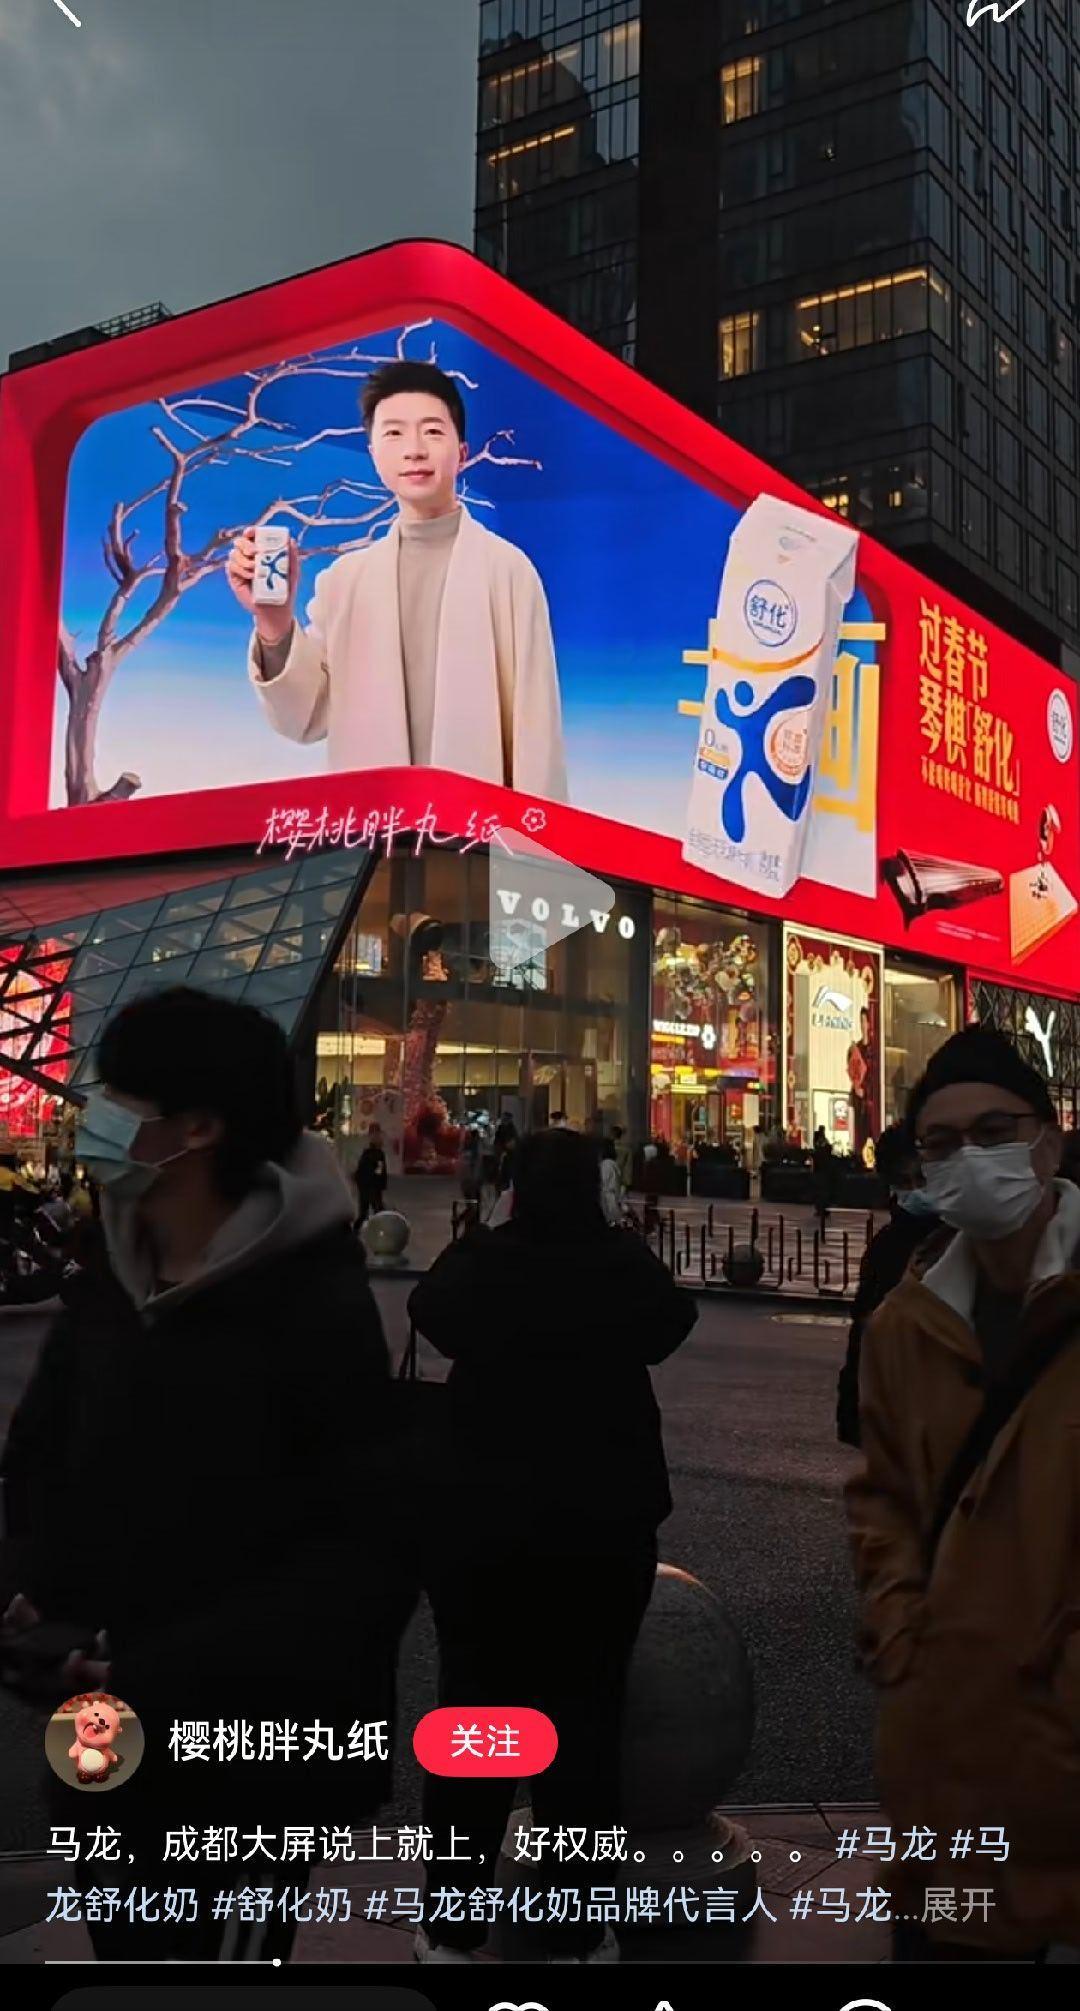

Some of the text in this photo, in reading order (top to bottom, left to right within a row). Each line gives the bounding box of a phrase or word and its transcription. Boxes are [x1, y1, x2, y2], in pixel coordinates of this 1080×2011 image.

[919, 597, 988, 702] 过春节
[497, 890, 635, 939] VOLVO
